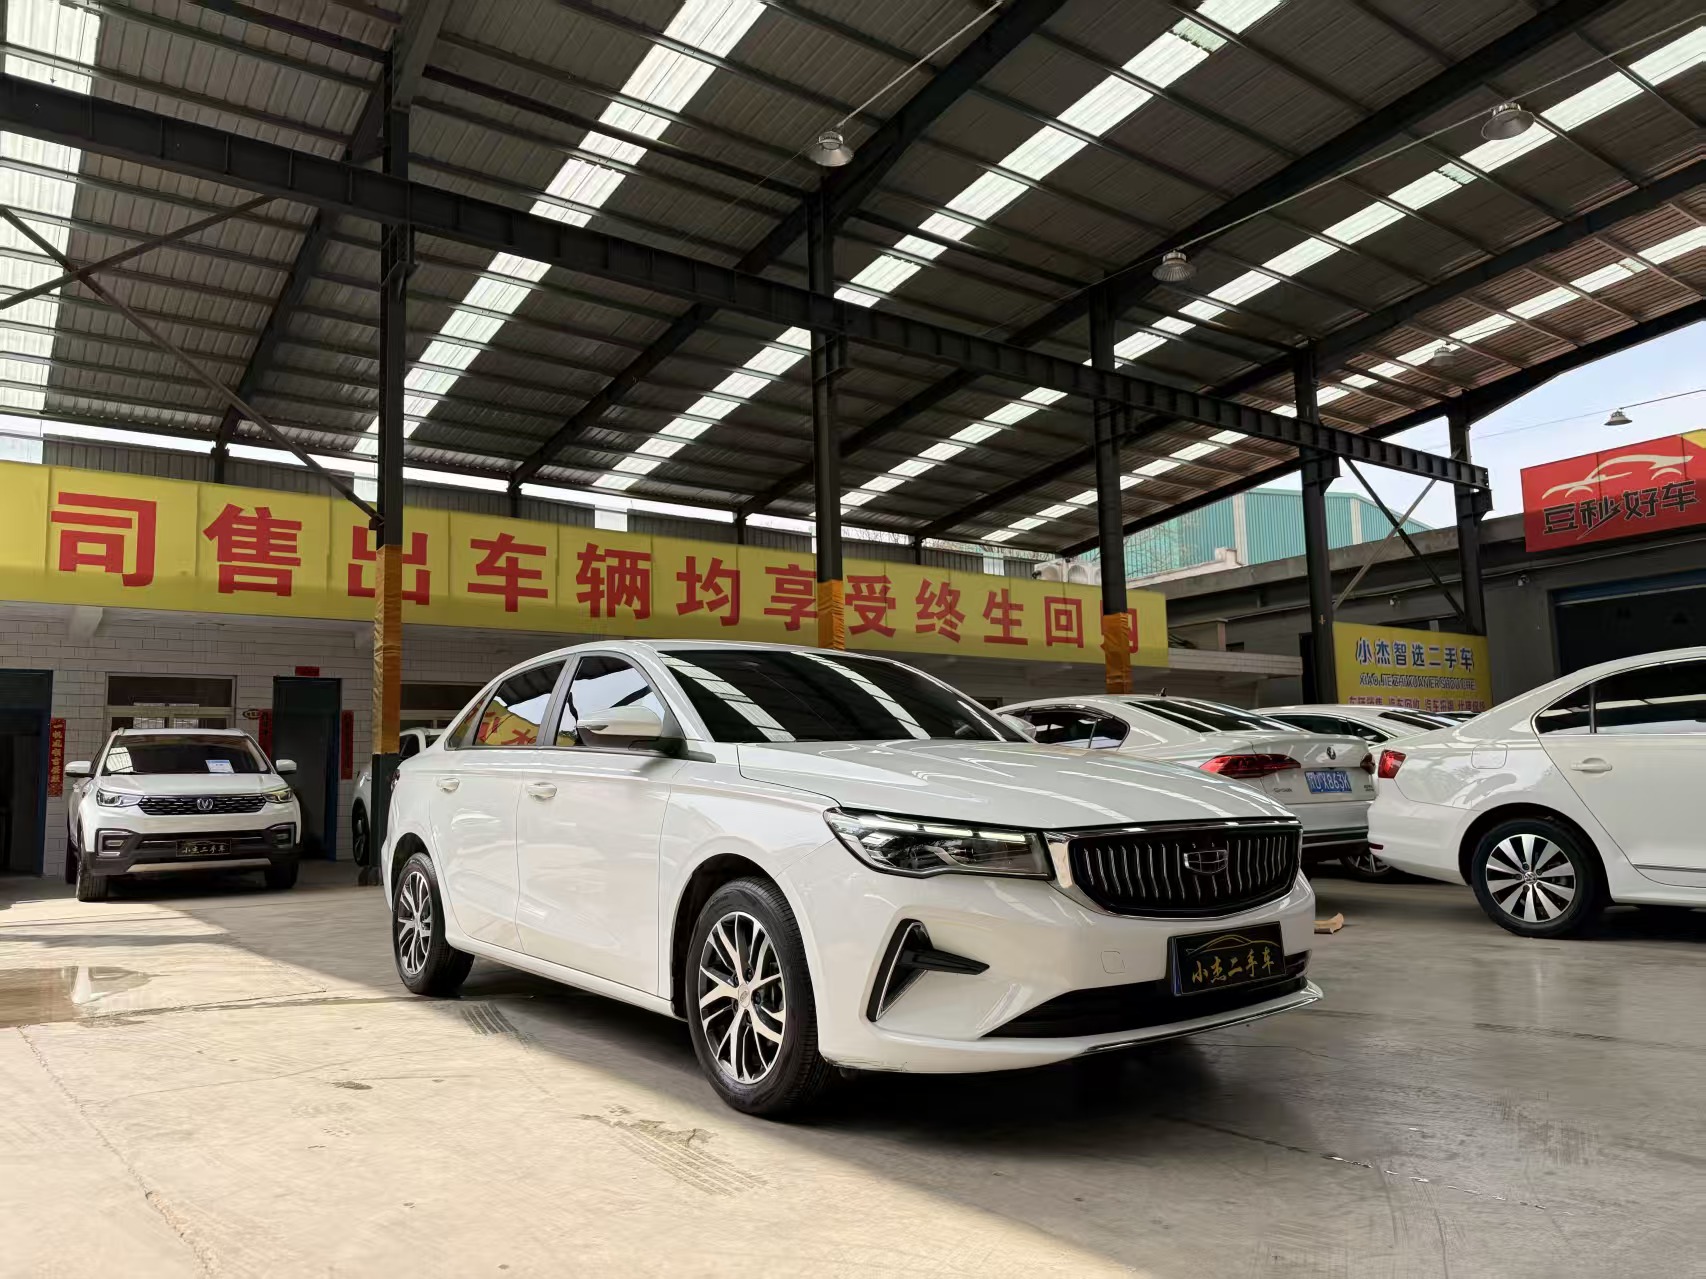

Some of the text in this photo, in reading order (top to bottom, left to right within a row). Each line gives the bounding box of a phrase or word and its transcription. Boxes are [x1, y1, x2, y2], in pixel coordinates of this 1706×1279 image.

[1543, 480, 1699, 540] 豆秒好车
[1355, 637, 1475, 672] 小杰智选二手车
[1192, 946, 1275, 983] 小杰二手车
